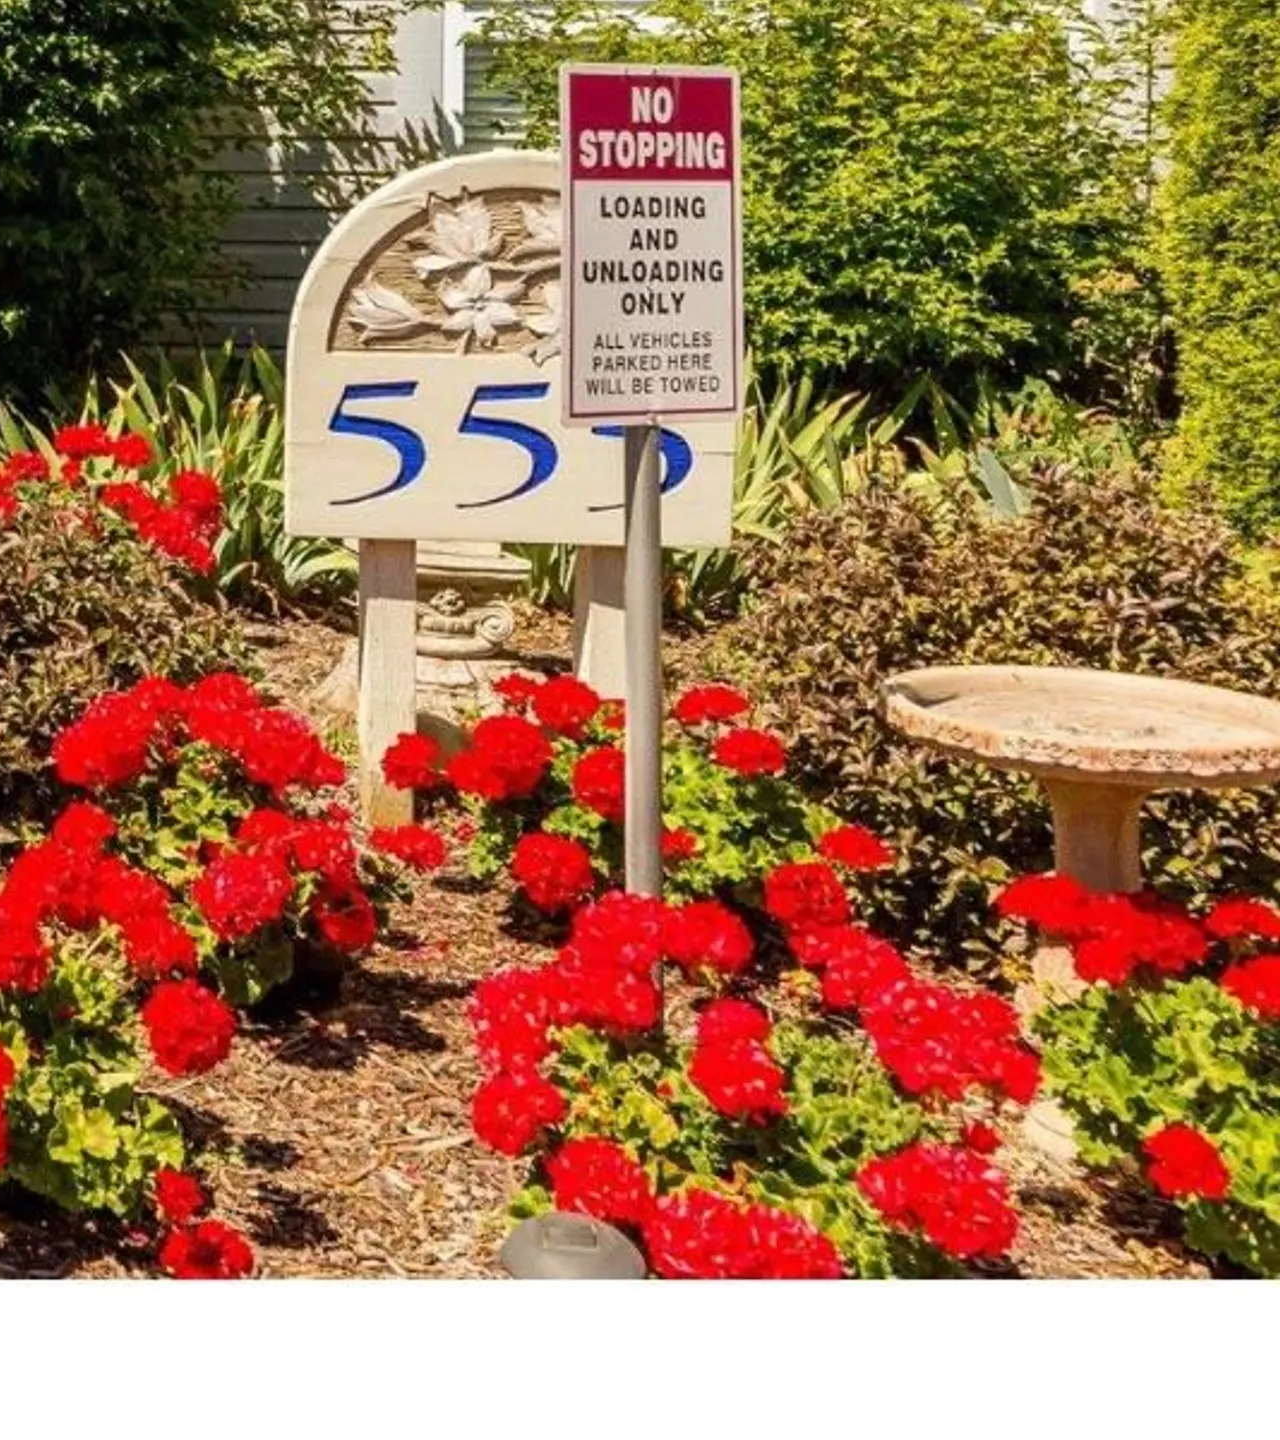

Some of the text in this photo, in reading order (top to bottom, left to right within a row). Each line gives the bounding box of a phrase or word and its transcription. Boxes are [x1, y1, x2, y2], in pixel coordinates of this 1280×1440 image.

[631, 86, 674, 124] NO
[578, 129, 726, 169] STOPPING
[600, 196, 706, 219] LOADING
[629, 228, 679, 251] AND
[582, 260, 724, 283] UNLOADING
[620, 291, 685, 315] ONLY
[593, 331, 713, 350] ALL VEHICLES
[592, 353, 713, 372] PARKED HERE
[585, 375, 721, 396] WILL BE TOWED
